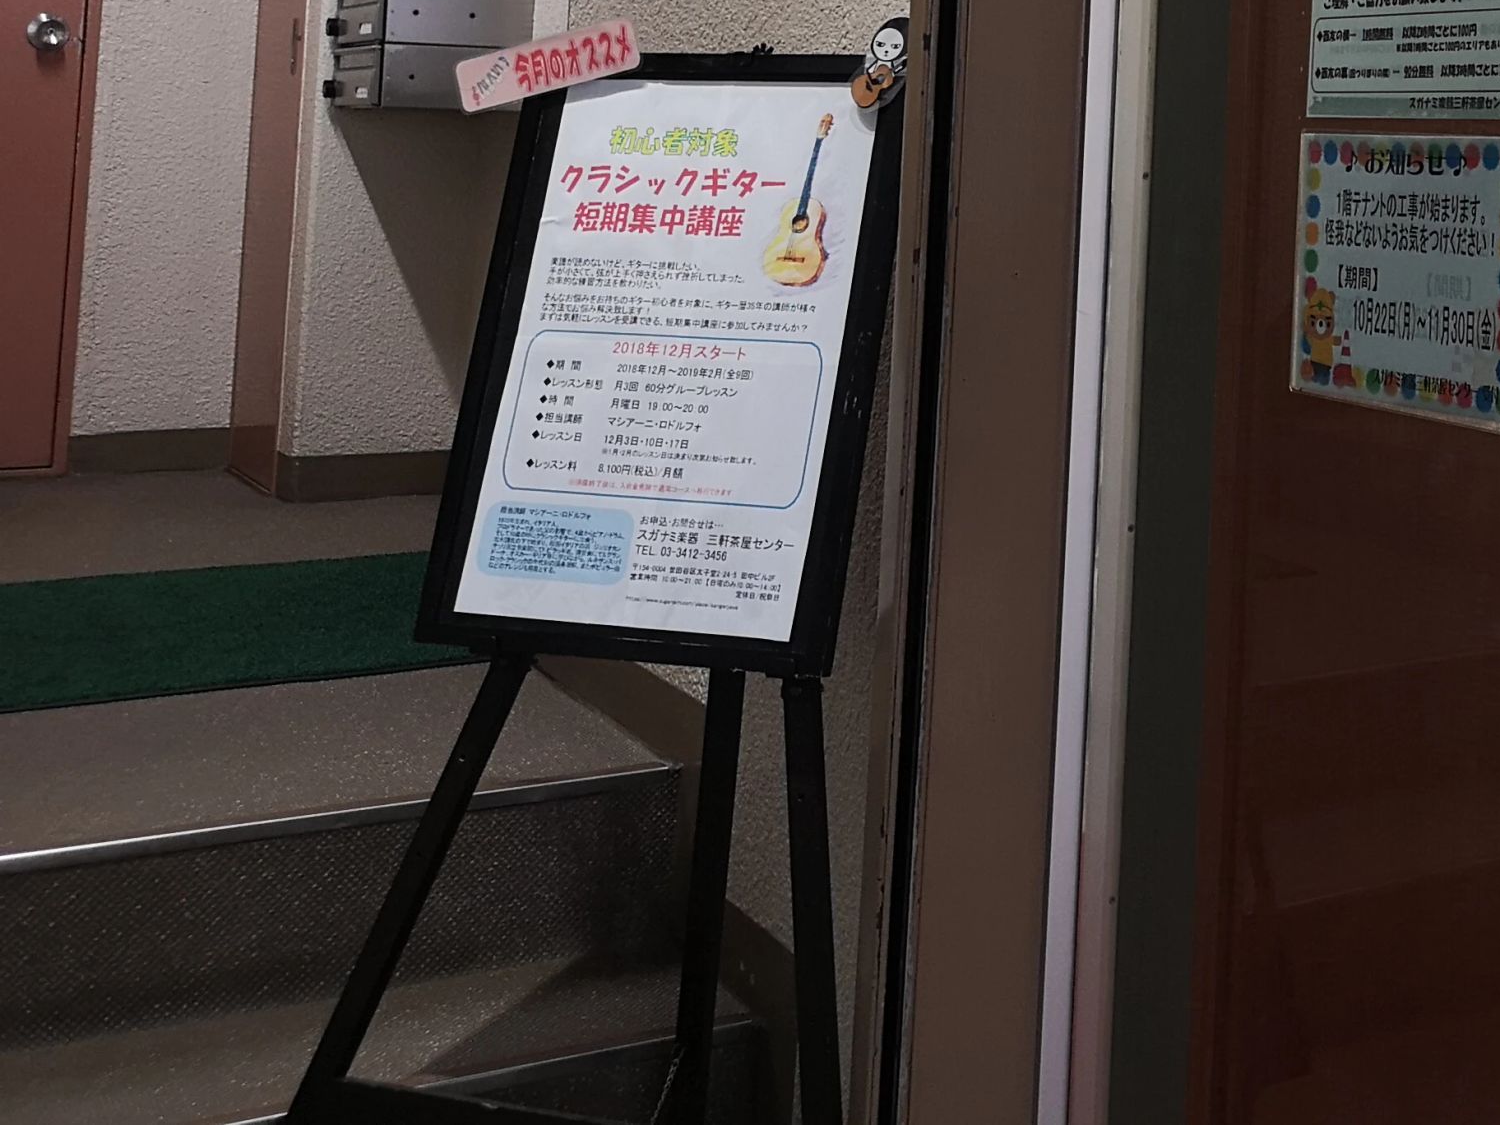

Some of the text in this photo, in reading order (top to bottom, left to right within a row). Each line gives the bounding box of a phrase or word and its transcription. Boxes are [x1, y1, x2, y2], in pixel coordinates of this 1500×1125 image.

[514, 25, 631, 92] 今月のオススメ
[609, 125, 739, 157] 初心者対象
[1364, 149, 1447, 177] お知らせ
[559, 165, 786, 196] クラシックギター
[1335, 189, 1487, 226] 1階テナントの工事が始まります。
[573, 202, 745, 237] 短期集中講座
[1336, 264, 1380, 292] 【期間】
[612, 341, 747, 360] 2018年12月スタート
[614, 382, 638, 392] 月3回
[610, 398, 640, 410] 月曜日
[544, 412, 583, 425] 担当講師
[540, 430, 582, 442] レッスン日
[534, 459, 578, 471] レッスン料
[636, 529, 795, 552] スガナミ楽器 三軒茶屋センター
[660, 546, 728, 562] 03-3412-3456
